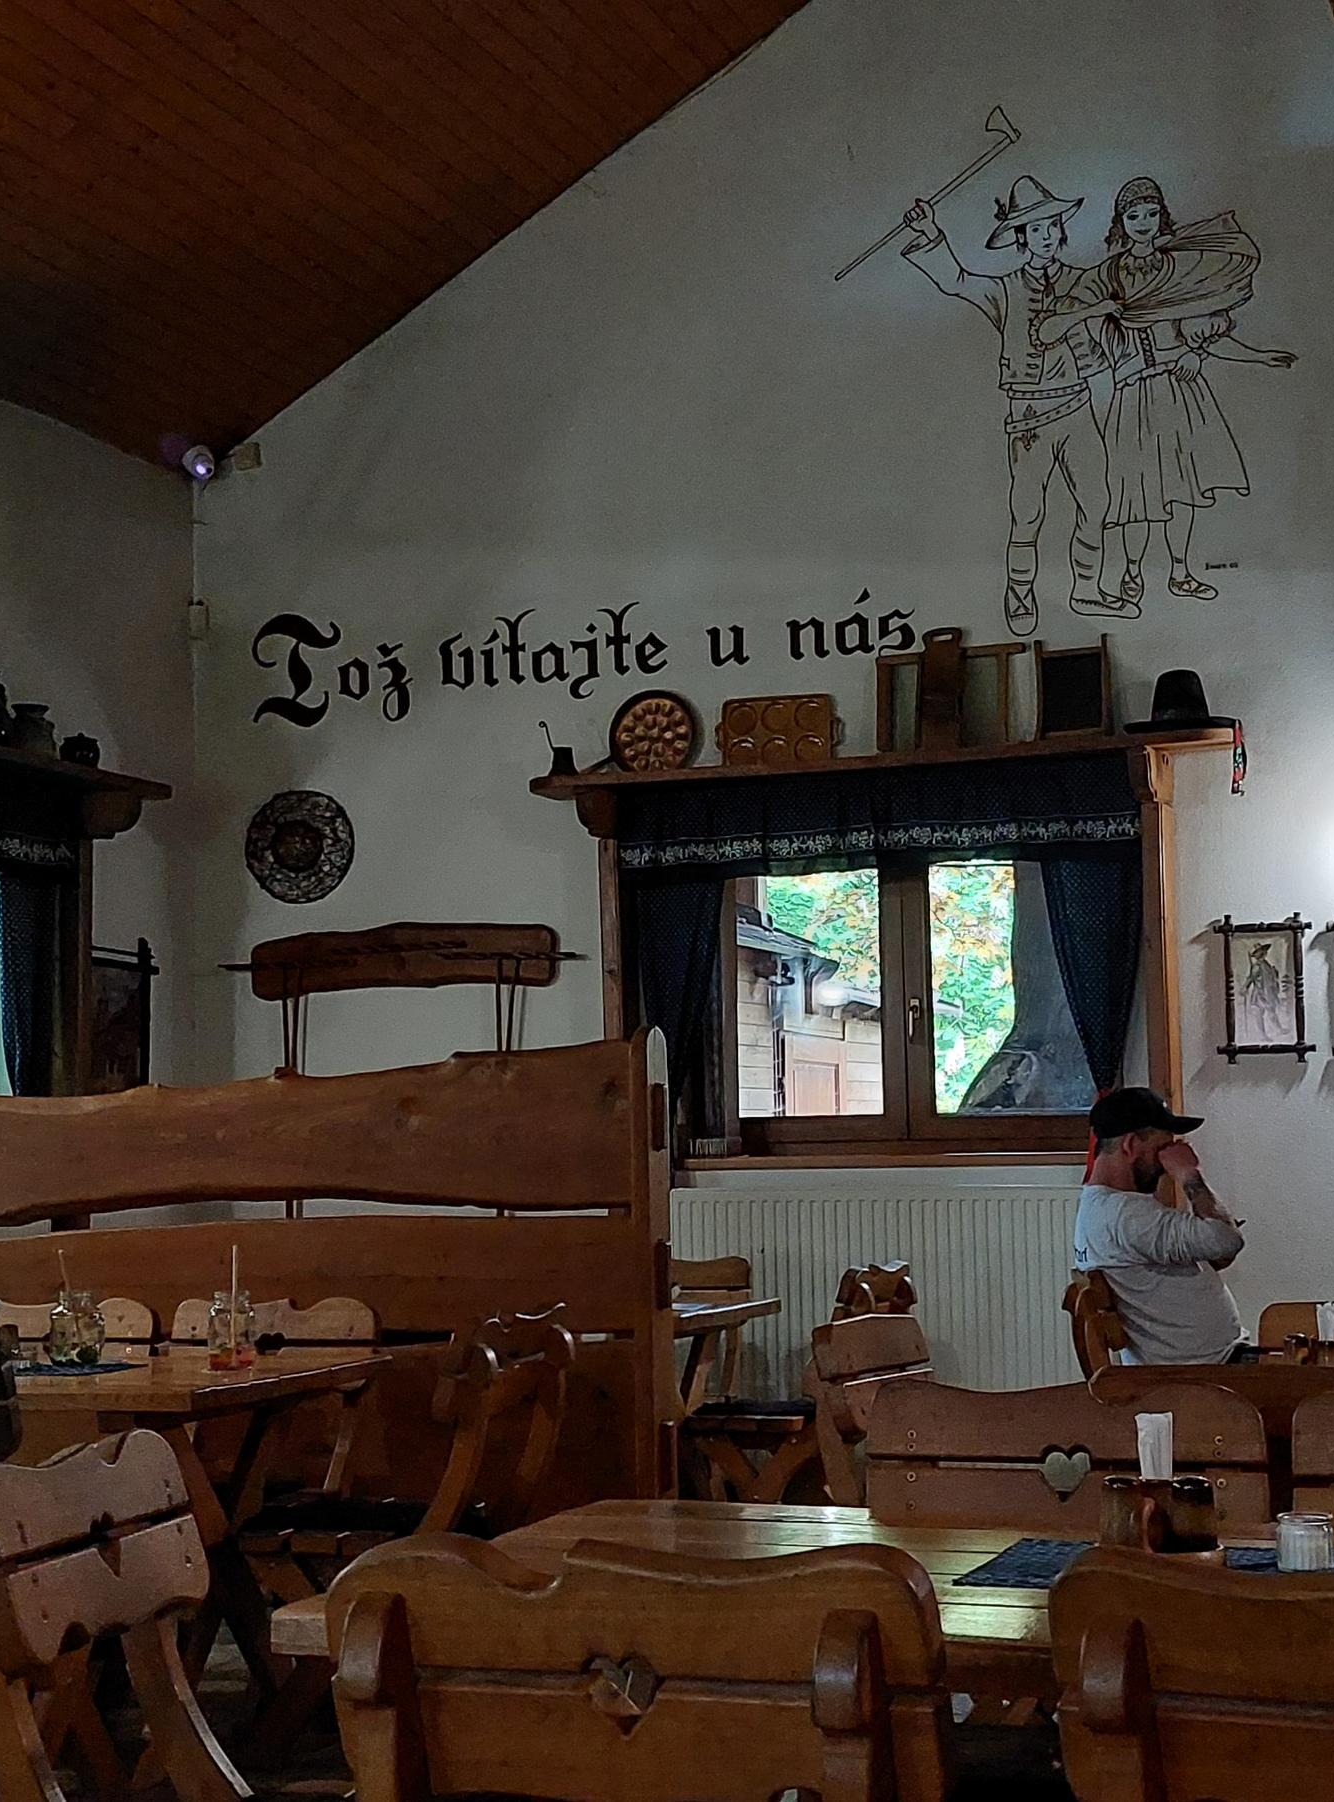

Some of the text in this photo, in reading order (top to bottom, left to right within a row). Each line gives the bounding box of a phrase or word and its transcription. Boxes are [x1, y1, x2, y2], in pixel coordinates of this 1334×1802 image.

[251, 587, 917, 728] Tož vítajte u nás
